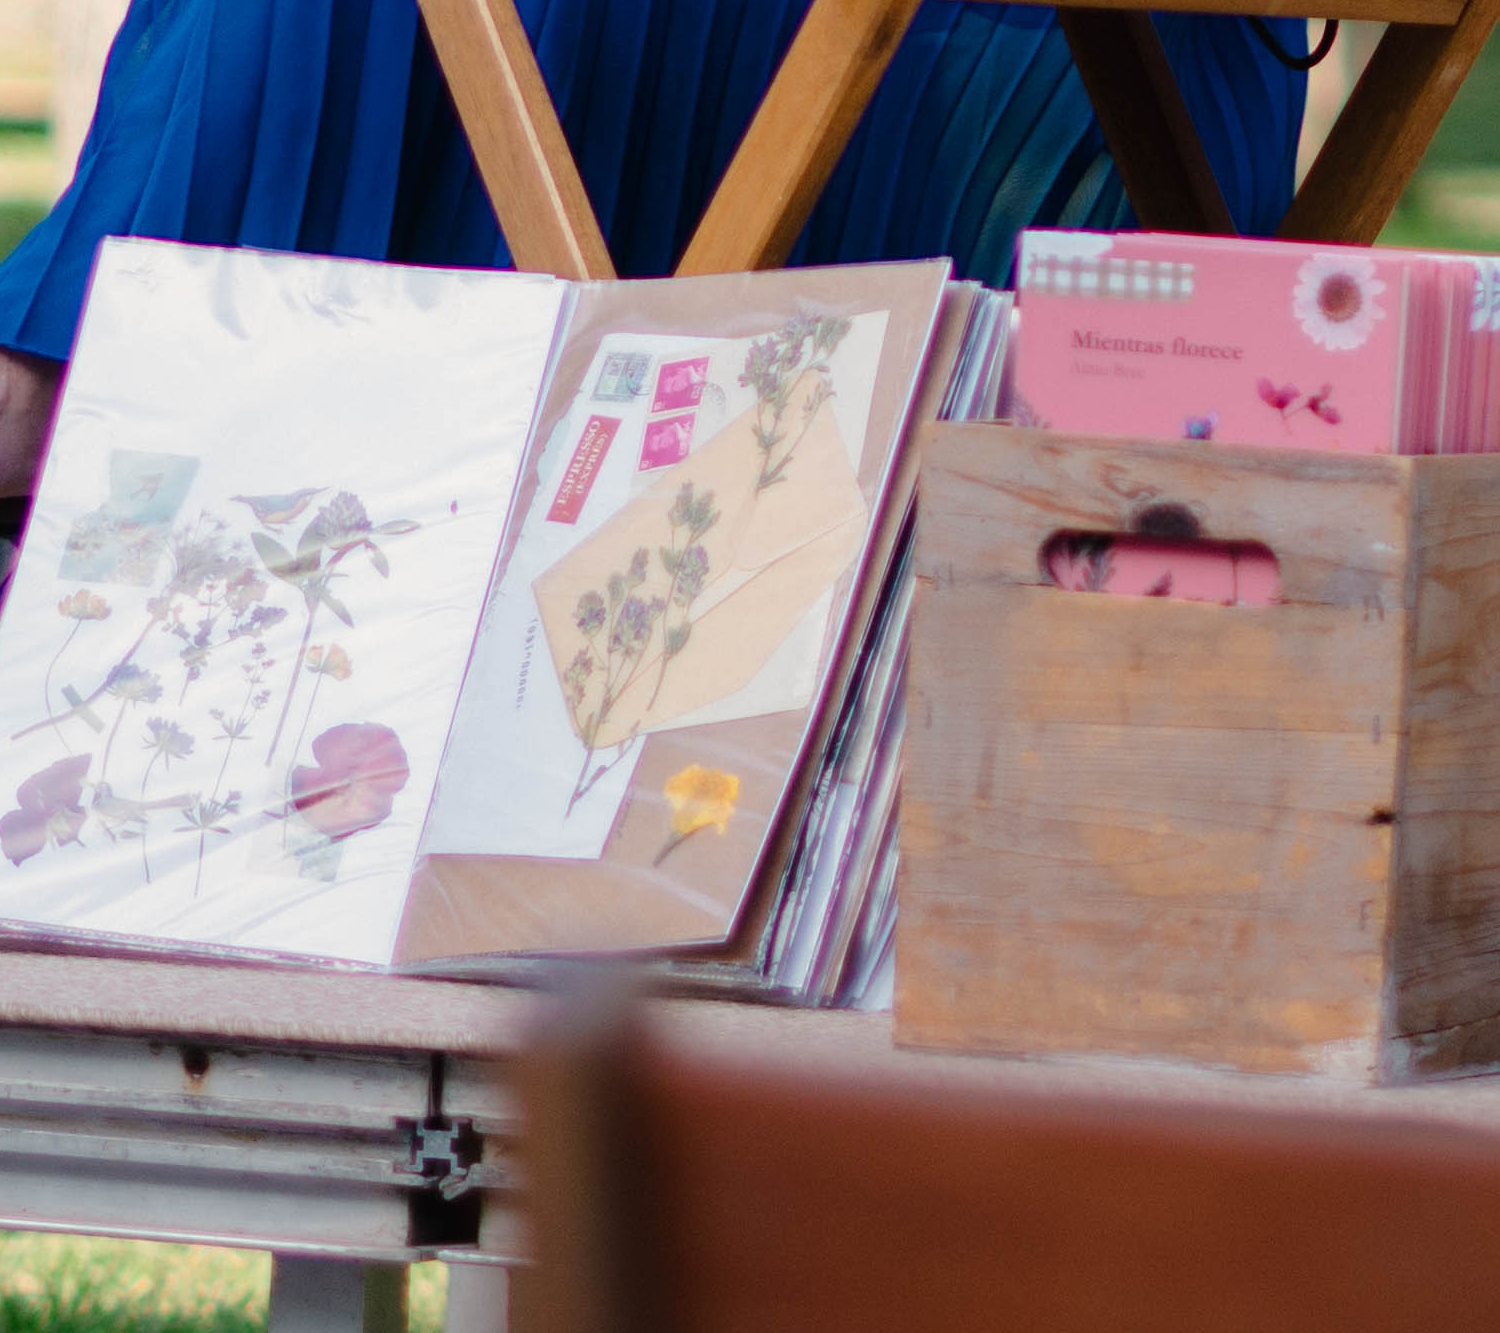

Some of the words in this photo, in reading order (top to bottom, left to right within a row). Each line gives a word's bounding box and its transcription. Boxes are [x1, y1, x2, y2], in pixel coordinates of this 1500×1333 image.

[1070, 330, 1164, 355] Mientras
[1170, 336, 1243, 360] florece
[556, 420, 601, 506] ESPRESSO
